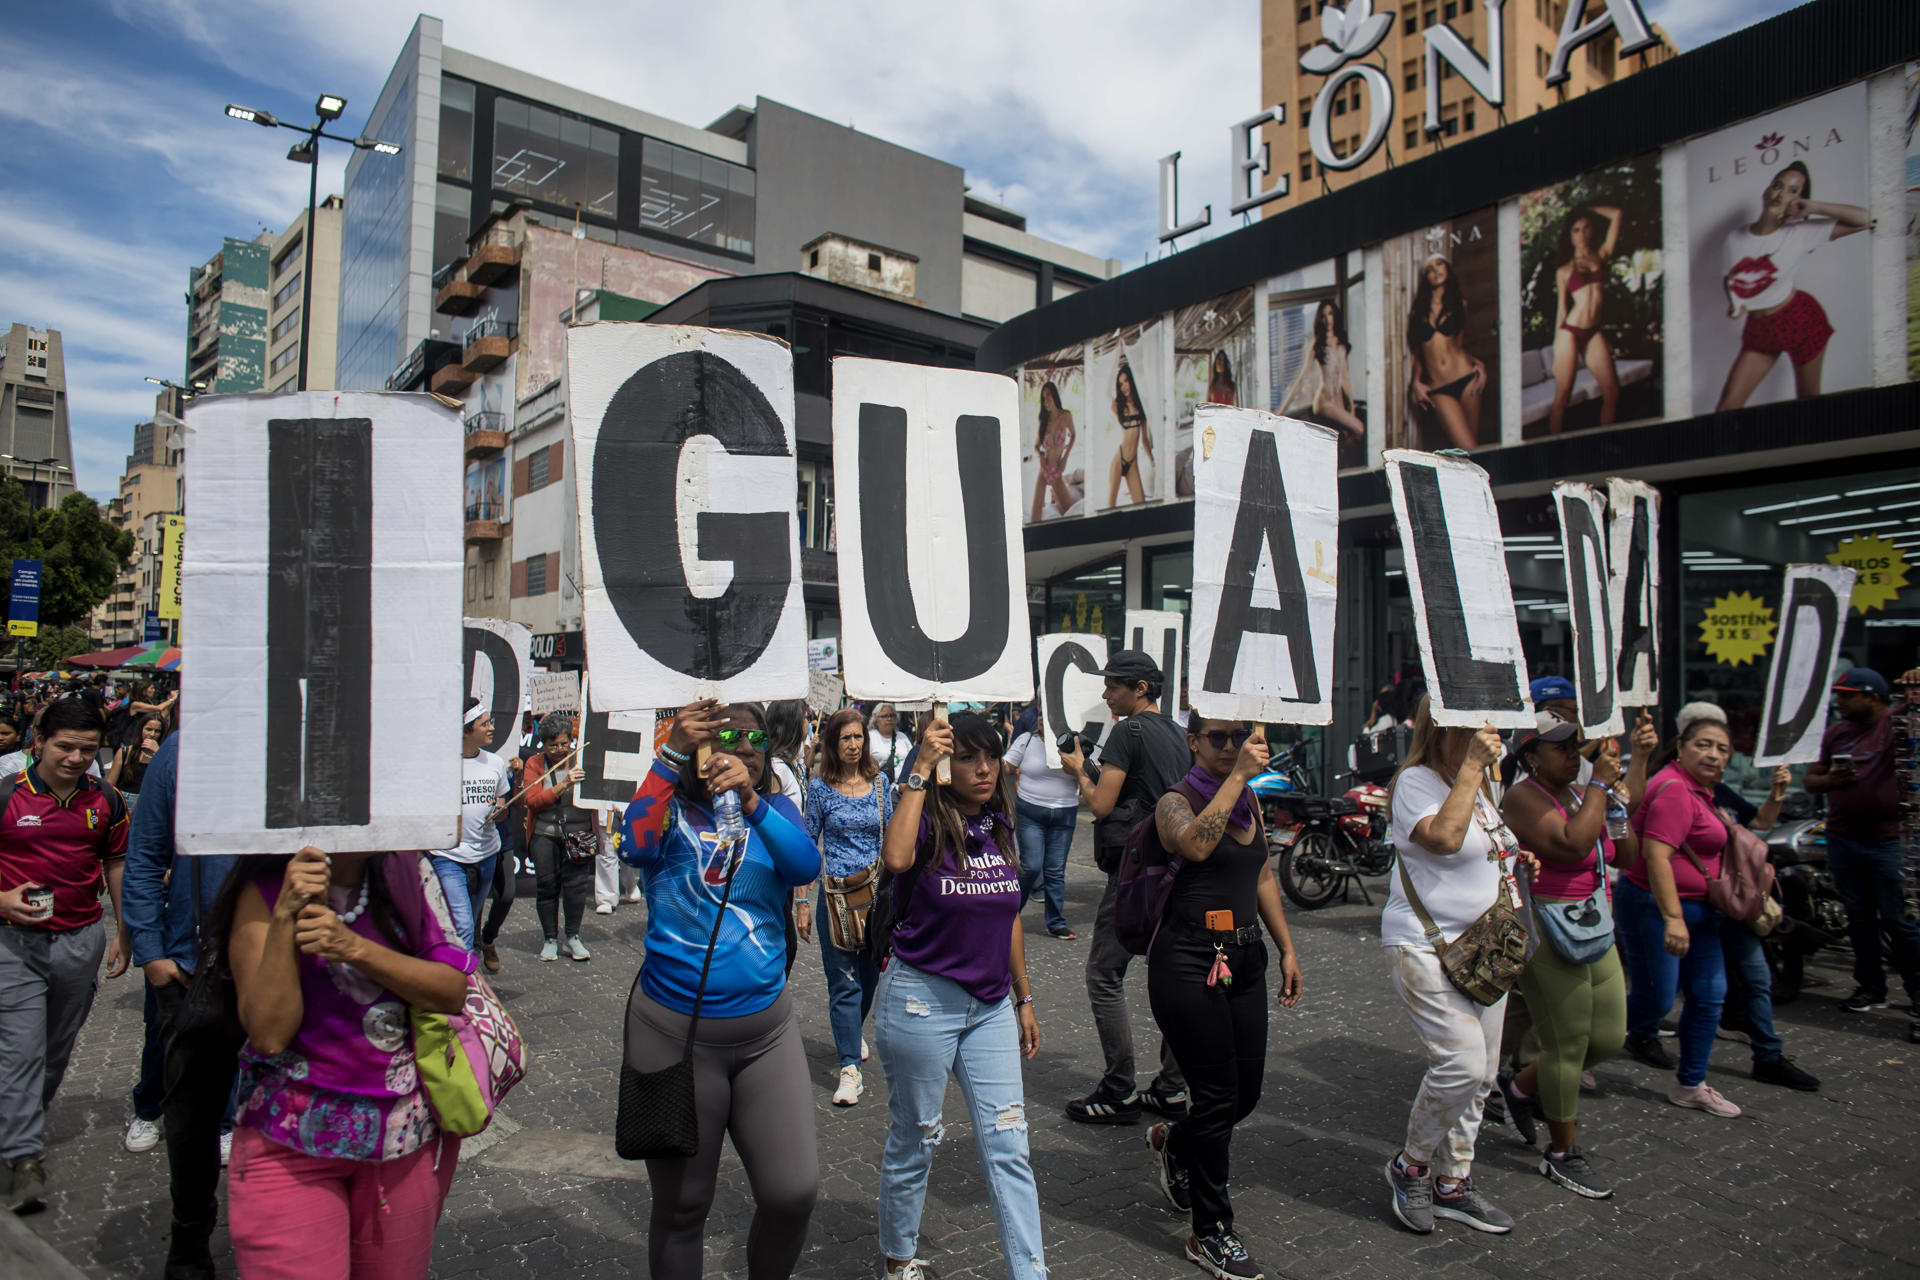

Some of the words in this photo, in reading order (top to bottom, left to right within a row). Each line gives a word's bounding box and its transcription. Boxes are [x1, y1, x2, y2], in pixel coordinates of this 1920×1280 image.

[1158, 0, 1661, 243] LEONA
[1708, 127, 1844, 184] LEONA
[593, 350, 791, 680] G
[859, 402, 1010, 682] U
[1203, 429, 1322, 704] A
[1399, 461, 1525, 711] L
[1562, 496, 1614, 727] D
[1617, 496, 1658, 692] A
[1711, 611, 1767, 626] SOSTÉN
[1763, 577, 1838, 758] D
[970, 870, 990, 880] POR
[992, 868, 1005, 879] LA
